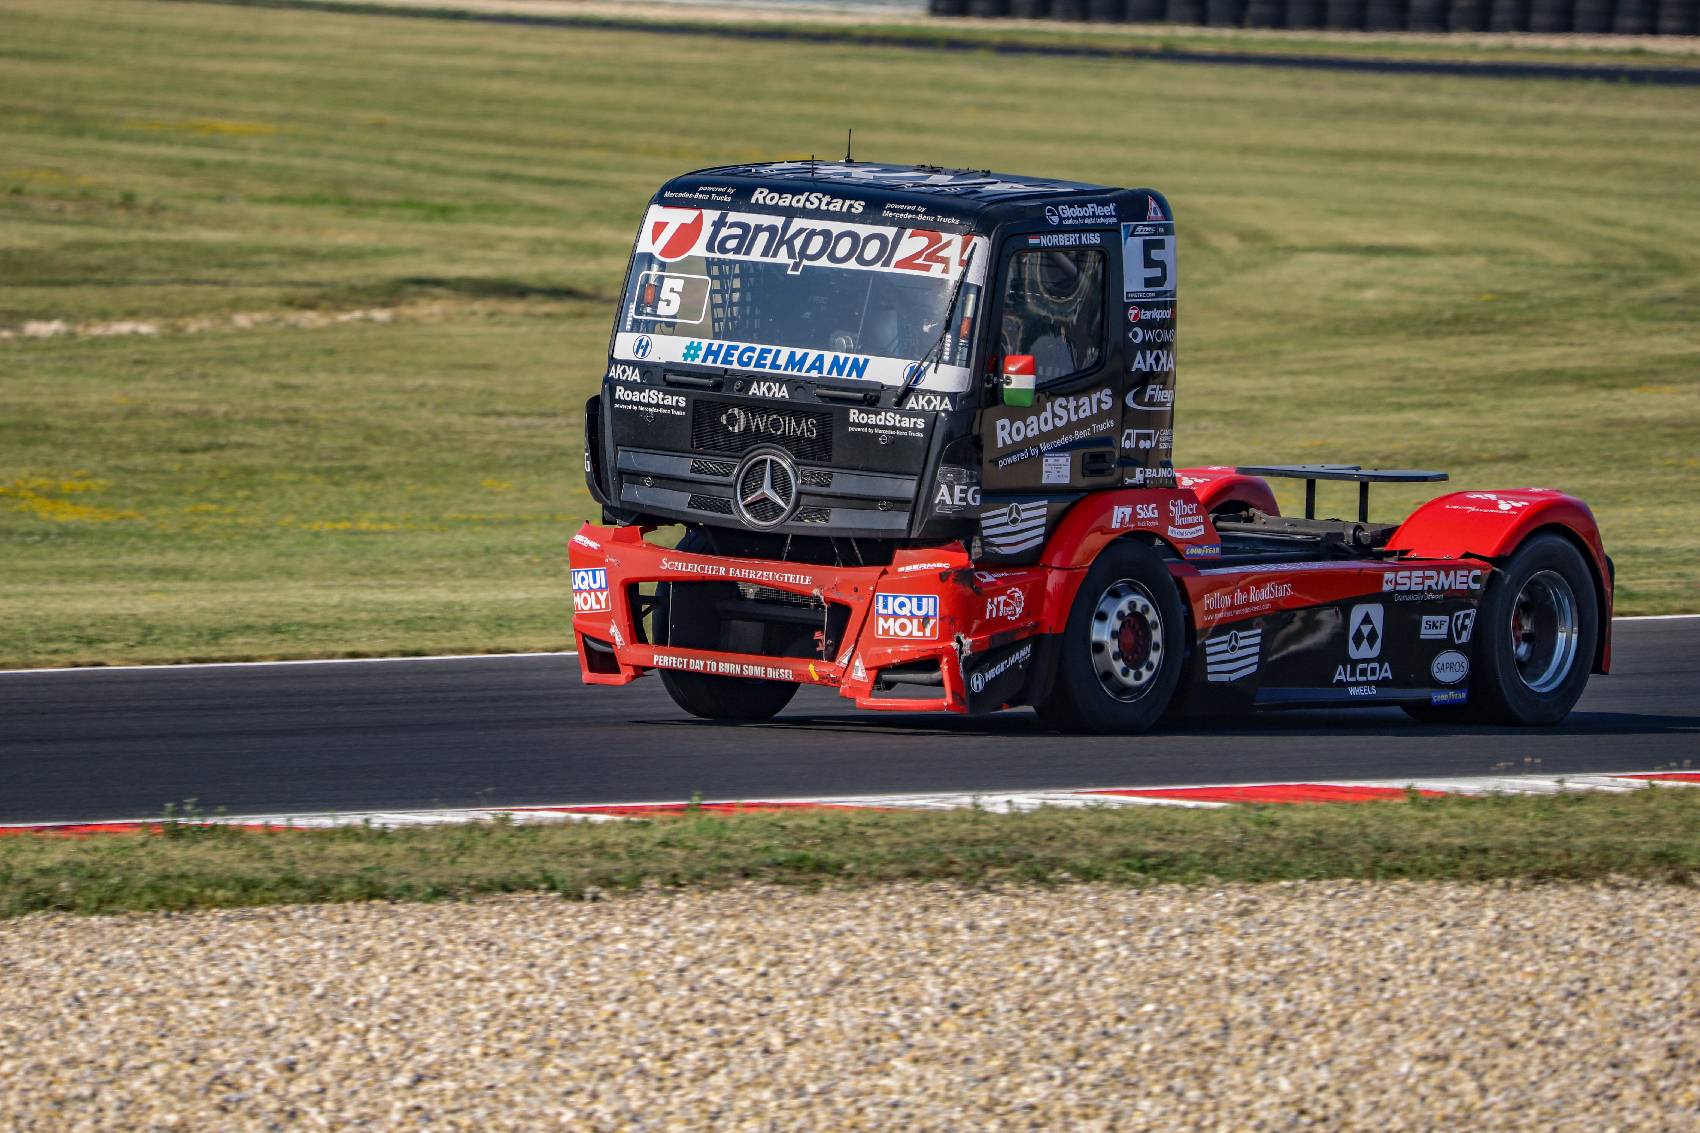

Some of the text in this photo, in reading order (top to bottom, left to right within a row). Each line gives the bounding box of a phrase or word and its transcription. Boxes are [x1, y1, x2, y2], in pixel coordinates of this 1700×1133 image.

[663, 190, 732, 202] Mercedes-Benz Trucks
[727, 186, 737, 194] by
[751, 187, 866, 214] RoadStars
[885, 203, 916, 211] powered
[882, 210, 960, 225] Mercedes-Benz Trucks
[1041, 233, 1101, 247] NORBERT KISS
[1143, 239, 1167, 288] 5
[656, 278, 685, 316] 5
[682, 341, 870, 379] #HEGELMANN
[1131, 350, 1174, 371] AKKA
[608, 364, 641, 383] AKKA
[615, 386, 686, 407] RoadStars
[749, 381, 789, 399] AKKA
[906, 394, 953, 411] AKKA
[849, 408, 925, 429] RoadStars
[996, 388, 1113, 448] RoadStars
[999, 449, 1029, 470] powered
[1029, 446, 1039, 458] by
[1040, 427, 1091, 453] Mercedes-Benz
[1092, 419, 1115, 434] Trucks
[935, 484, 980, 506] AEG
[1136, 503, 1159, 519] S&G
[1169, 499, 1198, 517] Silber
[1175, 514, 1204, 526] Brunnen
[1396, 570, 1482, 590] SERMEC
[877, 596, 935, 617] LIQUI
[1204, 582, 1294, 611] Follow the RoadStars.
[878, 617, 936, 637] MOLY
[1424, 620, 1447, 630] SKF
[653, 654, 688, 669] PERFECT
[689, 658, 706, 670] DAY
[706, 660, 717, 672] TO
[718, 662, 741, 675] BURN
[742, 664, 766, 677] SOME
[1333, 662, 1393, 683] ALCOA
[1435, 661, 1465, 674] SAPROS
[1348, 685, 1377, 696] WHEELS
